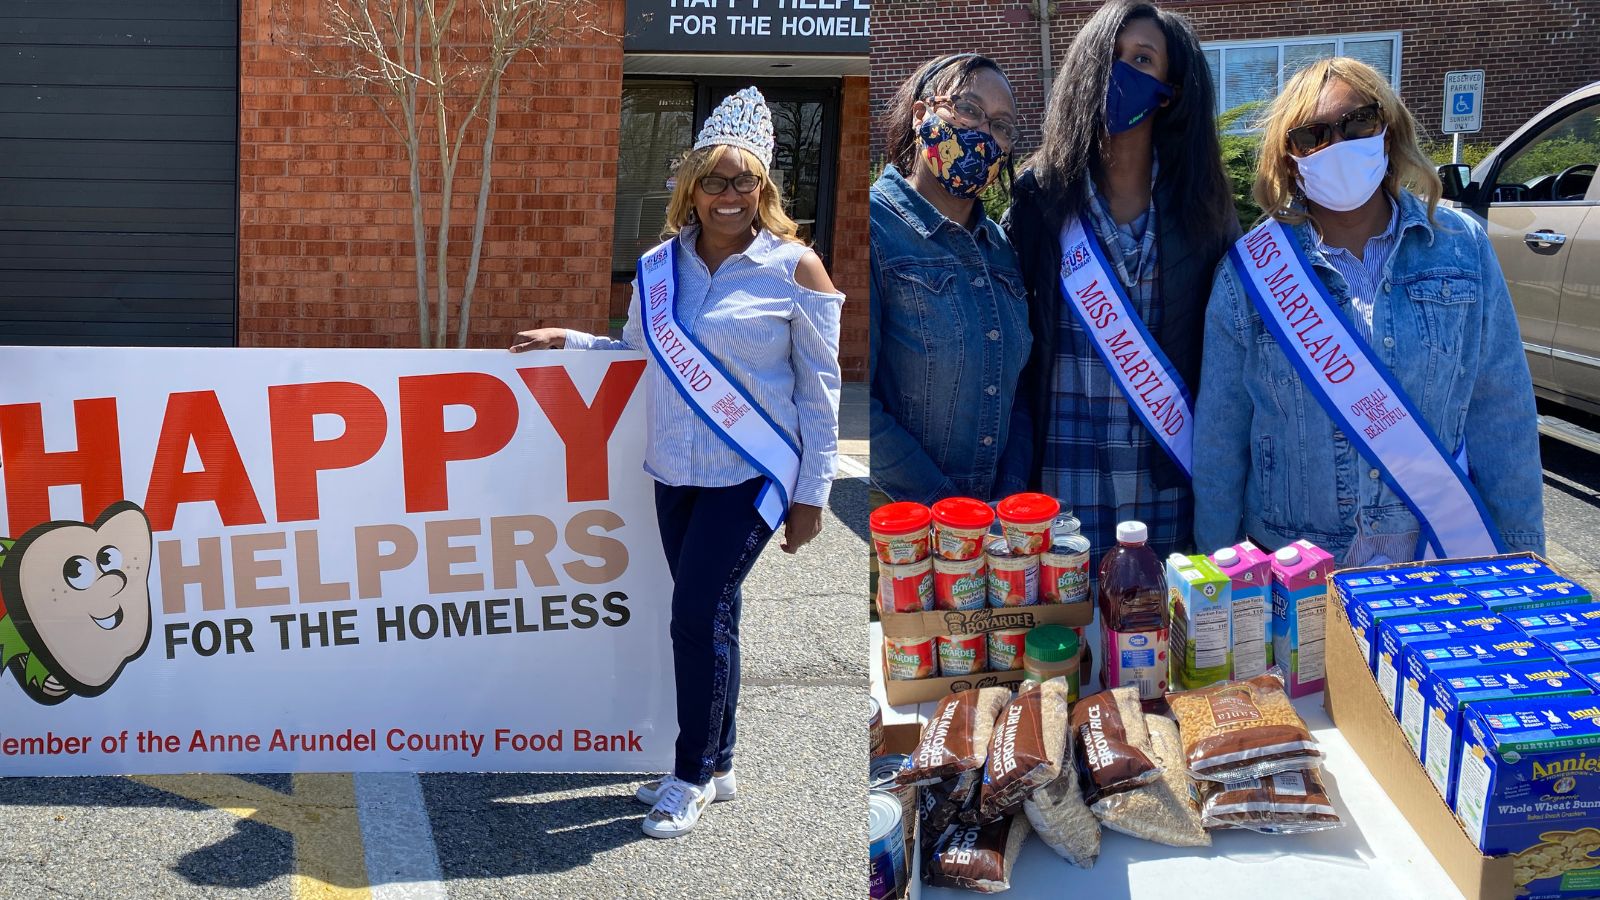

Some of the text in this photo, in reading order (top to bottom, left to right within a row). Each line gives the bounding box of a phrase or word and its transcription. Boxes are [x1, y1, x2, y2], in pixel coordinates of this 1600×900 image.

[669, 15, 717, 35] FOR
[727, 15, 771, 36] THE
[1448, 74, 1481, 83] RESERVED
[1450, 84, 1479, 92] PARKING
[1069, 246, 1090, 266] USA
[649, 278, 668, 311] MISS
[1244, 225, 1356, 385] MISS MARYLAND
[651, 310, 712, 392] MARYLAND
[1075, 279, 1185, 437] MISS MARYLAND
[711, 392, 737, 414] OVERALL
[721, 403, 739, 417] MOST
[1350, 388, 1387, 417] OVERALL
[1365, 402, 1389, 423] MOST
[722, 404, 751, 429] BEAUTIFUL
[1363, 408, 1407, 440] BEAUTIFUL
[0, 360, 648, 538] HAPPY
[158, 509, 631, 615] HELPERS
[165, 591, 632, 660] FOR THE HOMELESS
[965, 613, 1032, 634] BOYARDEE
[1008, 704, 1023, 728] RICE
[1088, 704, 1100, 729] RICE
[1217, 711, 1259, 720] Santa
[100, 731, 128, 754] of
[137, 731, 181, 753] the
[188, 729, 261, 752] Anne
[268, 728, 376, 752] Arundel
[386, 728, 485, 757] County
[495, 729, 563, 752] Food
[573, 729, 643, 752] Bank
[930, 699, 960, 767] BROWN RICE
[1515, 740, 1574, 751] CERTIFIED
[919, 734, 934, 768] LONG
[992, 742, 1005, 780] LONG
[1002, 727, 1017, 774] BROWN
[1498, 804, 1532, 815] Whole
[1535, 801, 1571, 812] Wheat
[1539, 794, 1580, 803] Organic
[944, 827, 966, 864] LONG
